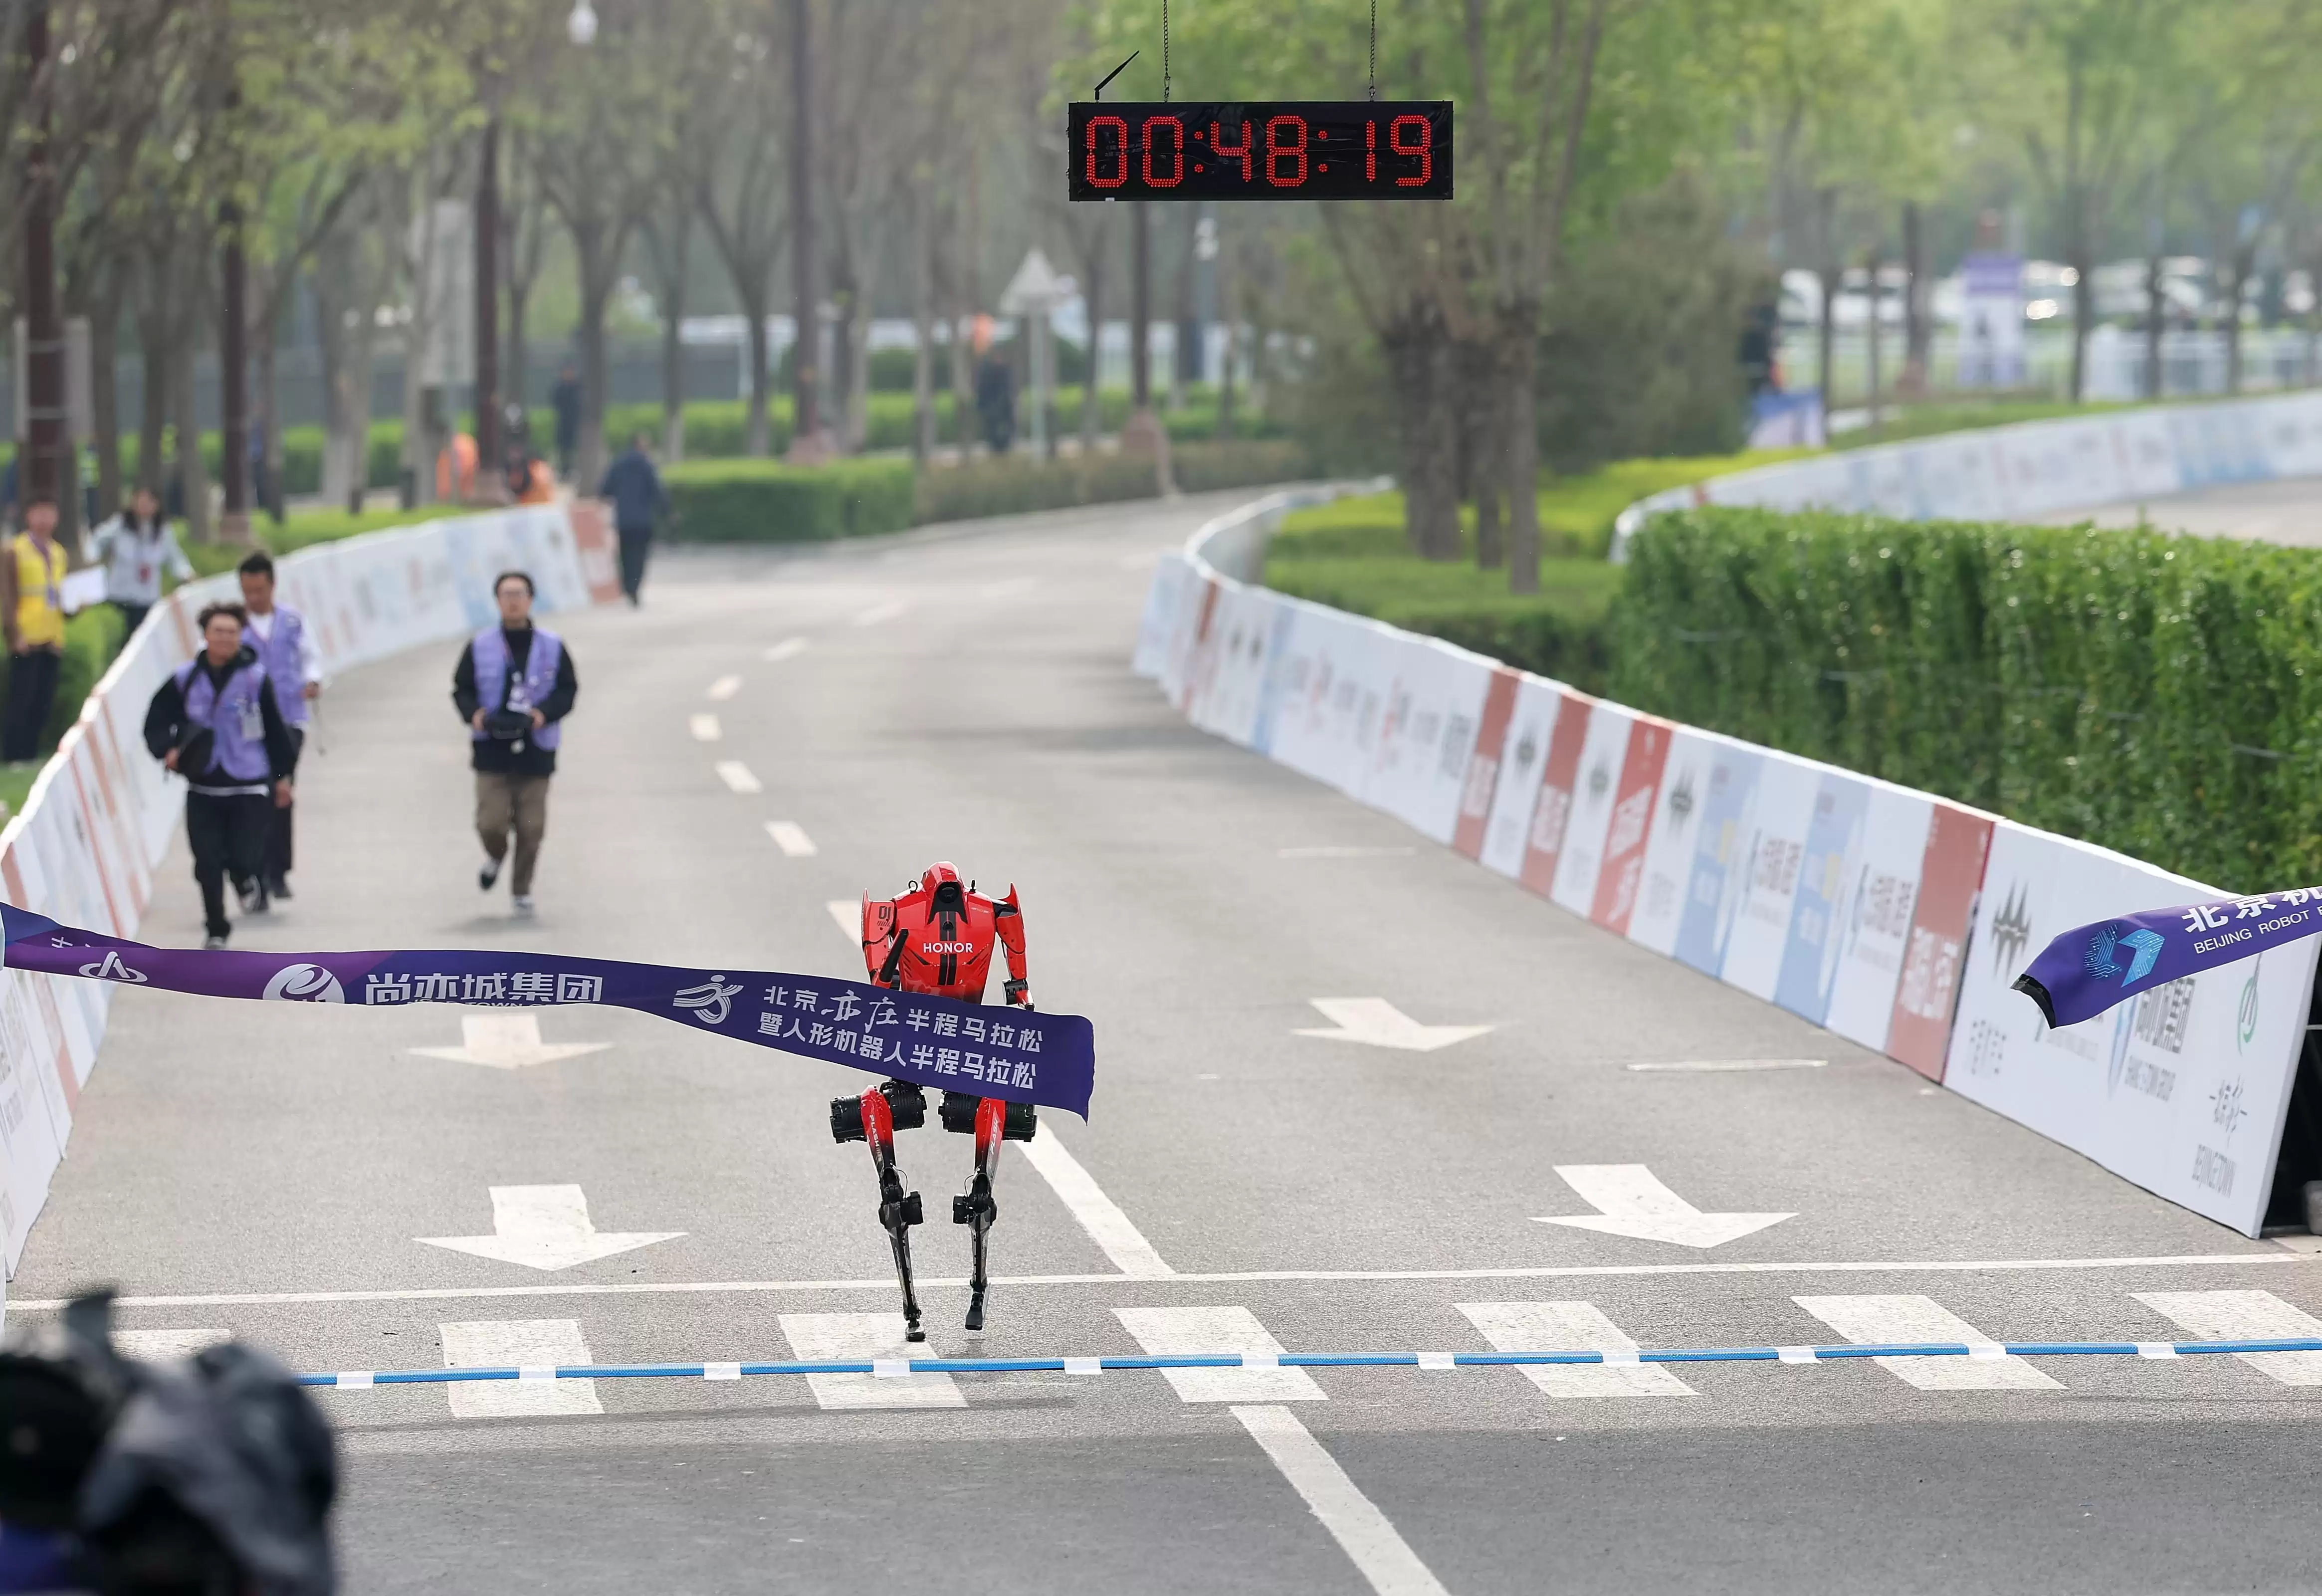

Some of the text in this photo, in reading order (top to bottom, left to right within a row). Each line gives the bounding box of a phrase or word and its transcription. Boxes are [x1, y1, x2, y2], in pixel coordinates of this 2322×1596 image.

[1086, 115, 1432, 188] 00:48:19
[923, 942, 974, 953] HONOR
[2194, 910, 2310, 954] BEIJING ROBOT
[366, 972, 603, 1005] 尚亦城集团
[757, 1011, 1038, 1089] 暨人形机器人半程马拉松
[869, 1115, 880, 1147] FLASH
[990, 1117, 999, 1155] FLASH
